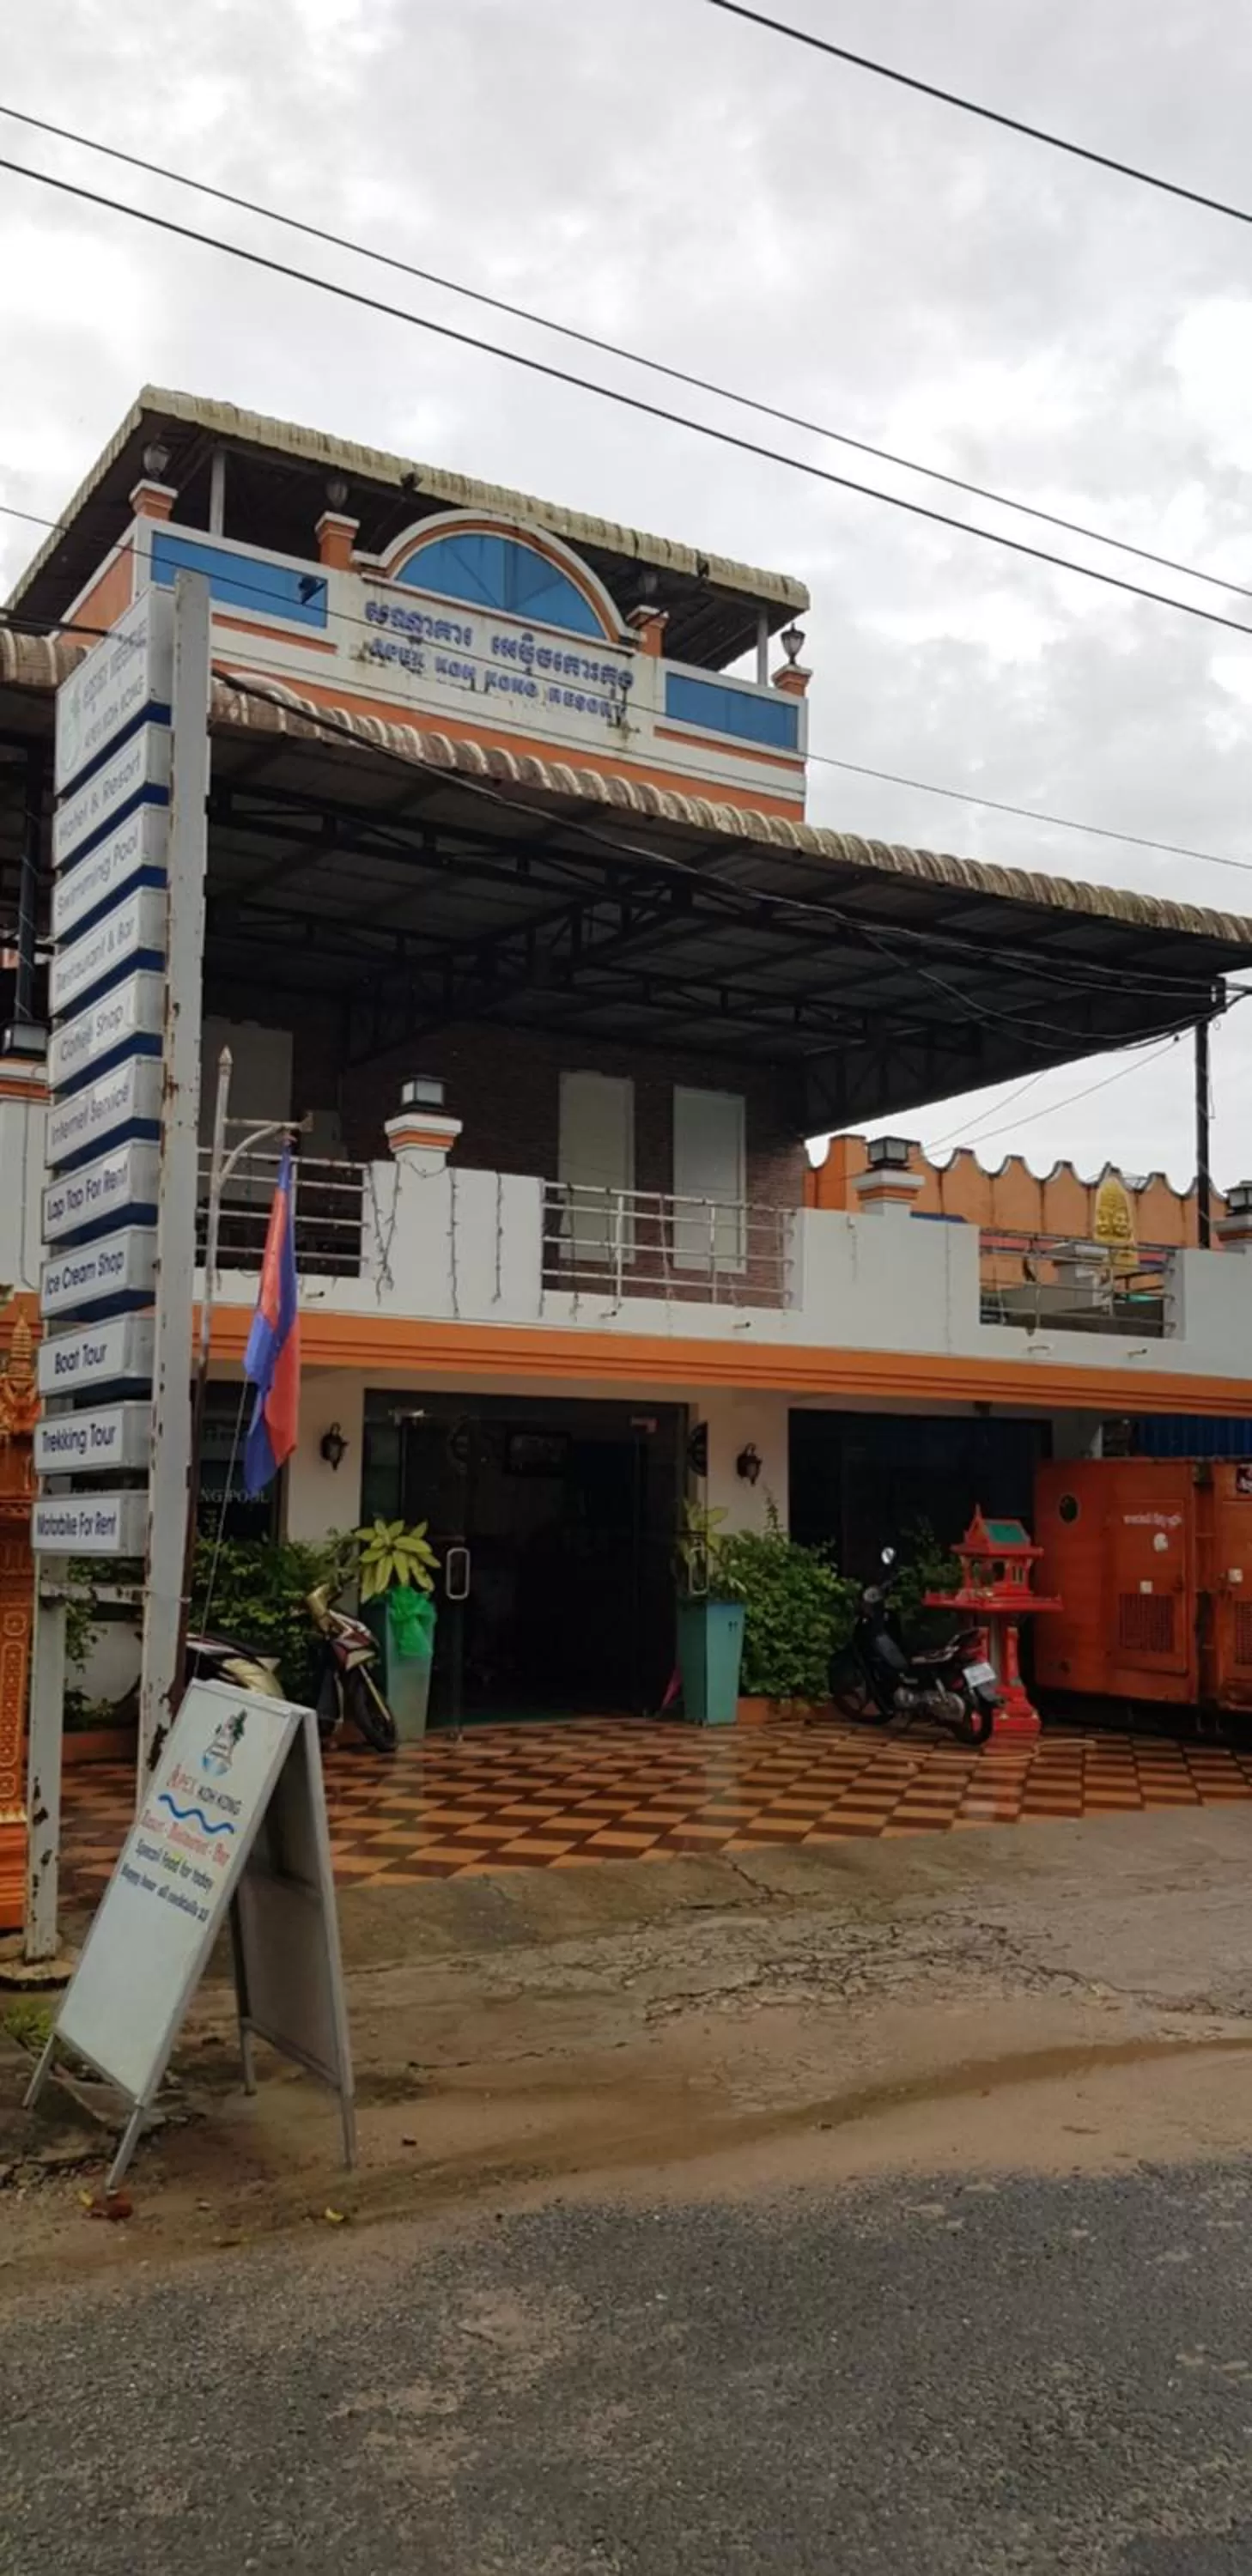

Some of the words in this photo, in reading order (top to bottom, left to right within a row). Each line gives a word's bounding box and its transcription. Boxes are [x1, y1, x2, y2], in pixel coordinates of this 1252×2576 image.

[369, 638, 424, 669] APEX
[435, 656, 476, 680] KOH
[484, 670, 538, 699] KONG
[547, 688, 627, 720] RESORT
[102, 753, 140, 800] Resort
[112, 830, 137, 867] Pool
[96, 1004, 124, 1038] Shop
[52, 1105, 88, 1145] Internet
[90, 1084, 129, 1120] Service
[47, 1193, 64, 1222] Lap
[66, 1187, 83, 1213] Top
[86, 1177, 101, 1202] For
[103, 1164, 128, 1195] Rent
[46, 1273, 59, 1295] Ice
[61, 1263, 95, 1290] Cream
[98, 1250, 125, 1277] Shop
[55, 1350, 79, 1375] Boat
[82, 1344, 107, 1365] Tour
[42, 1430, 86, 1455] Trekking
[89, 1423, 117, 1447] Tour
[79, 1512, 94, 1537] For
[95, 1512, 117, 1536] Rent
[197, 1785, 218, 1805] KOH
[217, 1793, 242, 1816] KONG
